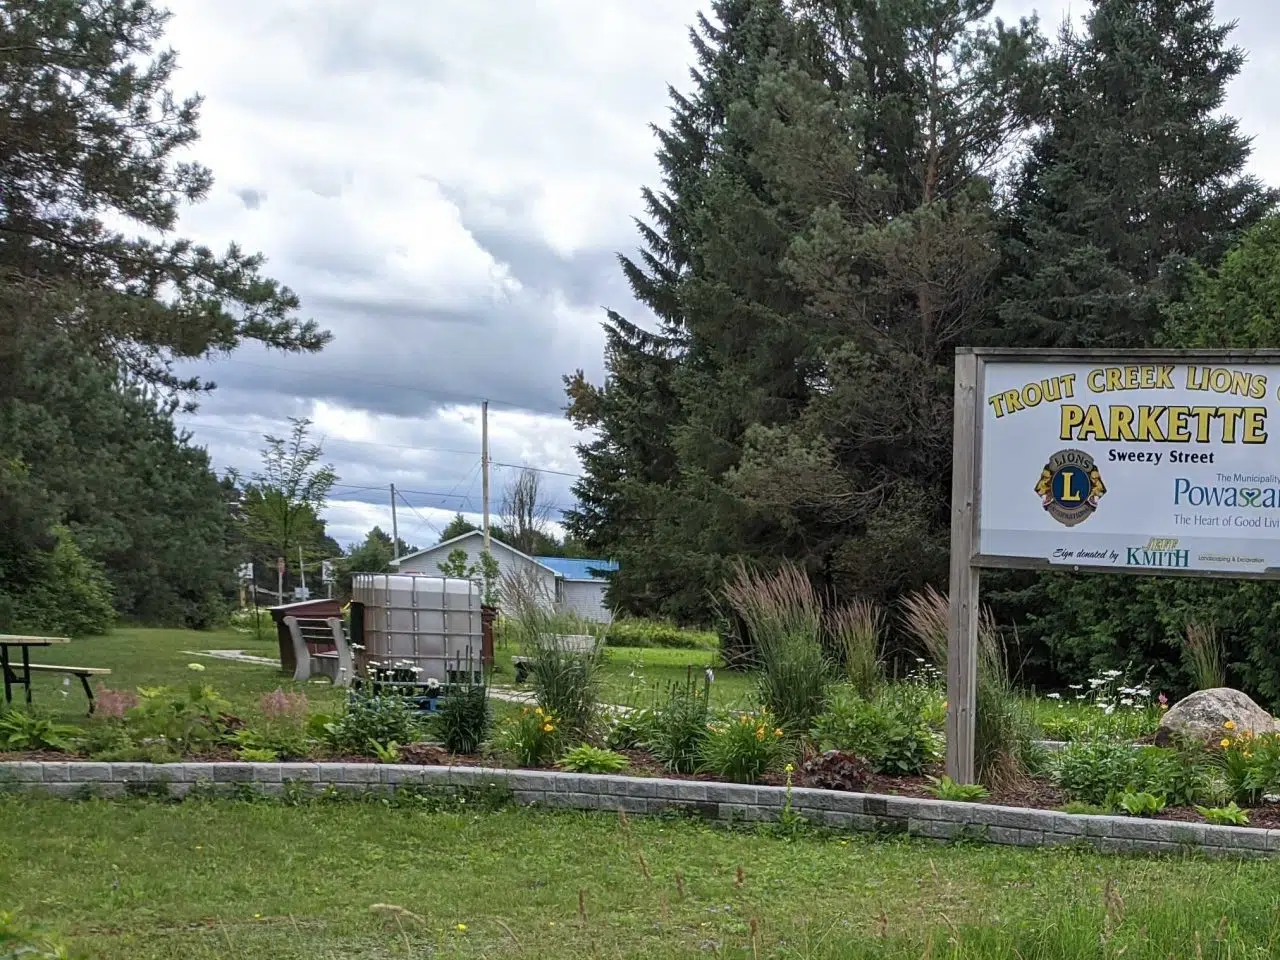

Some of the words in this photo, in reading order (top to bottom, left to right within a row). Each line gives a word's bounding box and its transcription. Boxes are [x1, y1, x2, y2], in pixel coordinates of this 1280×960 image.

[988, 373, 1076, 418] TROUT
[1086, 365, 1175, 393] CREEK
[1186, 366, 1267, 399] LIONS
[1060, 404, 1268, 444] PARKETTE
[1054, 453, 1091, 469] LIONS
[1108, 449, 1163, 466] Sweezy
[1169, 450, 1214, 463] Street
[1216, 473, 1232, 482] The
[1060, 472, 1081, 502] L
[1174, 514, 1192, 525] The
[1194, 515, 1219, 526] Heart
[1222, 517, 1232, 527] of
[1234, 516, 1261, 528] Good
[1076, 550, 1108, 560] donated
[1109, 550, 1119, 563] by
